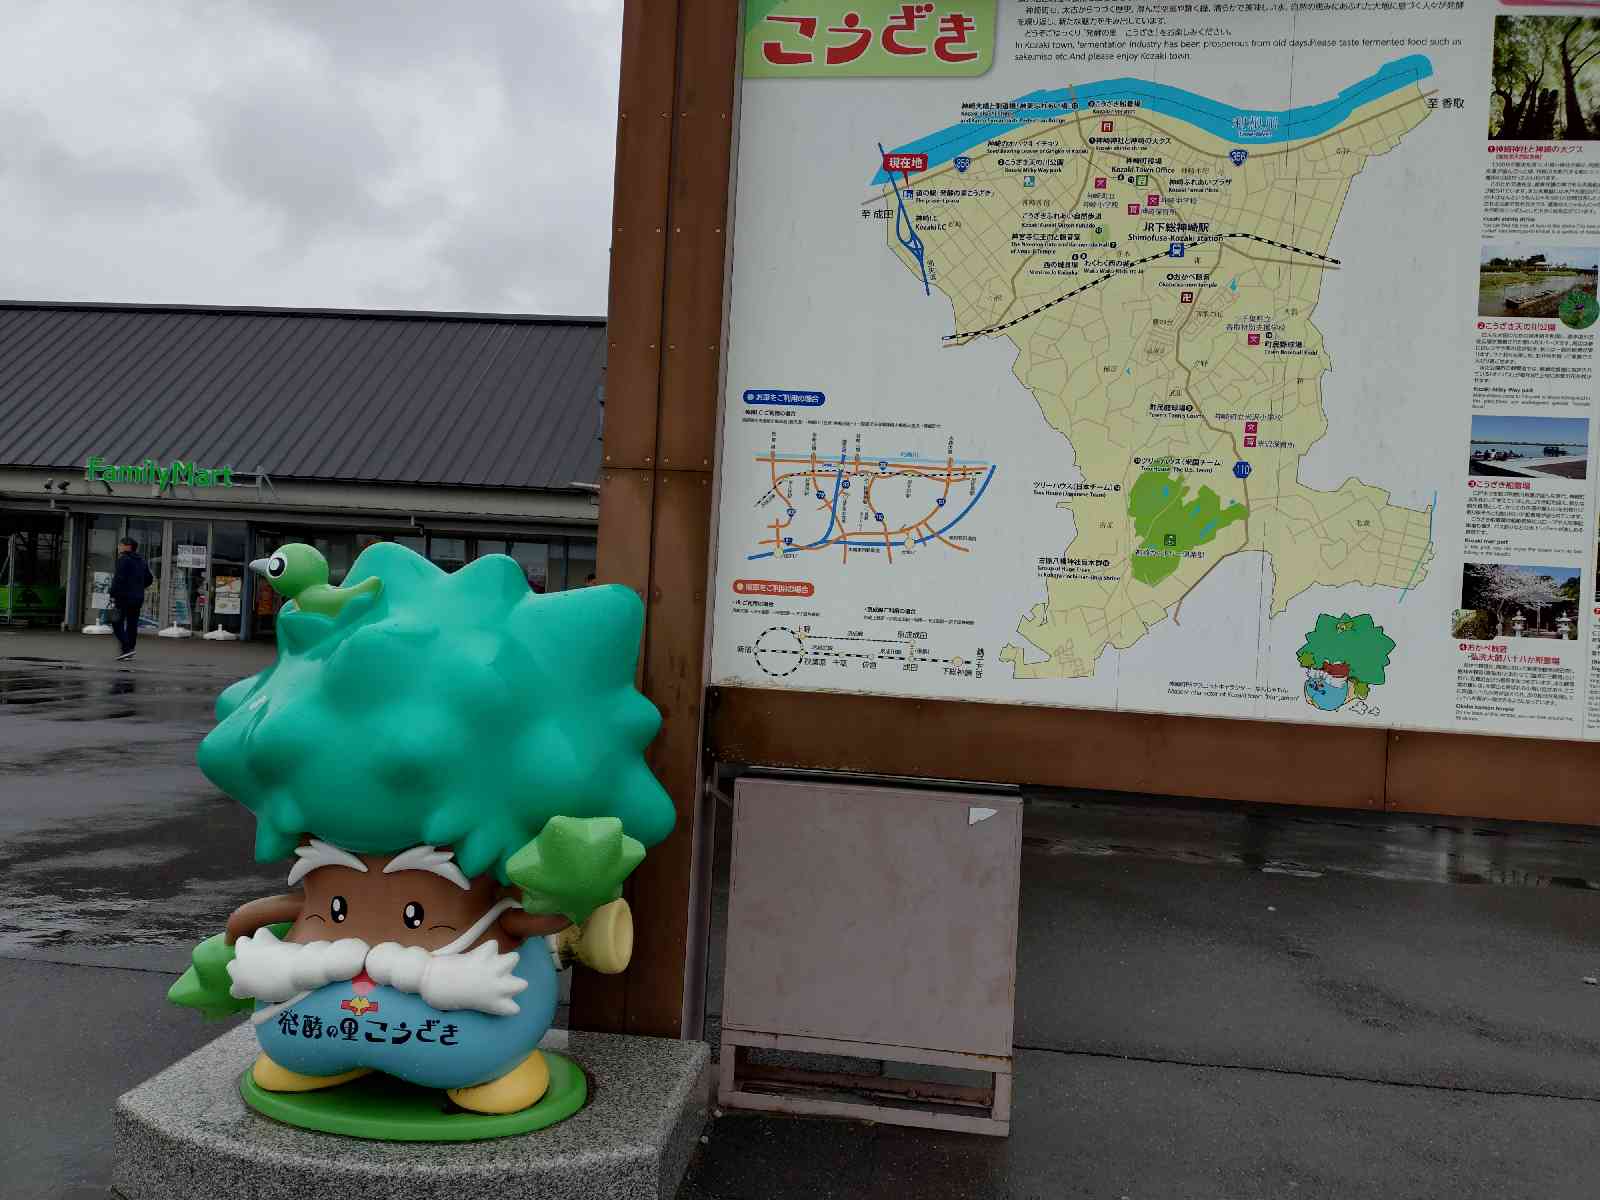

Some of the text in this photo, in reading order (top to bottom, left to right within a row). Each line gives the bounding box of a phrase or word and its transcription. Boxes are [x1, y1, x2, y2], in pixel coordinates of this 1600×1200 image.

[762, 3, 978, 65] こうざき
[888, 157, 923, 169] 現在地
[86, 455, 233, 491] FamilyMart
